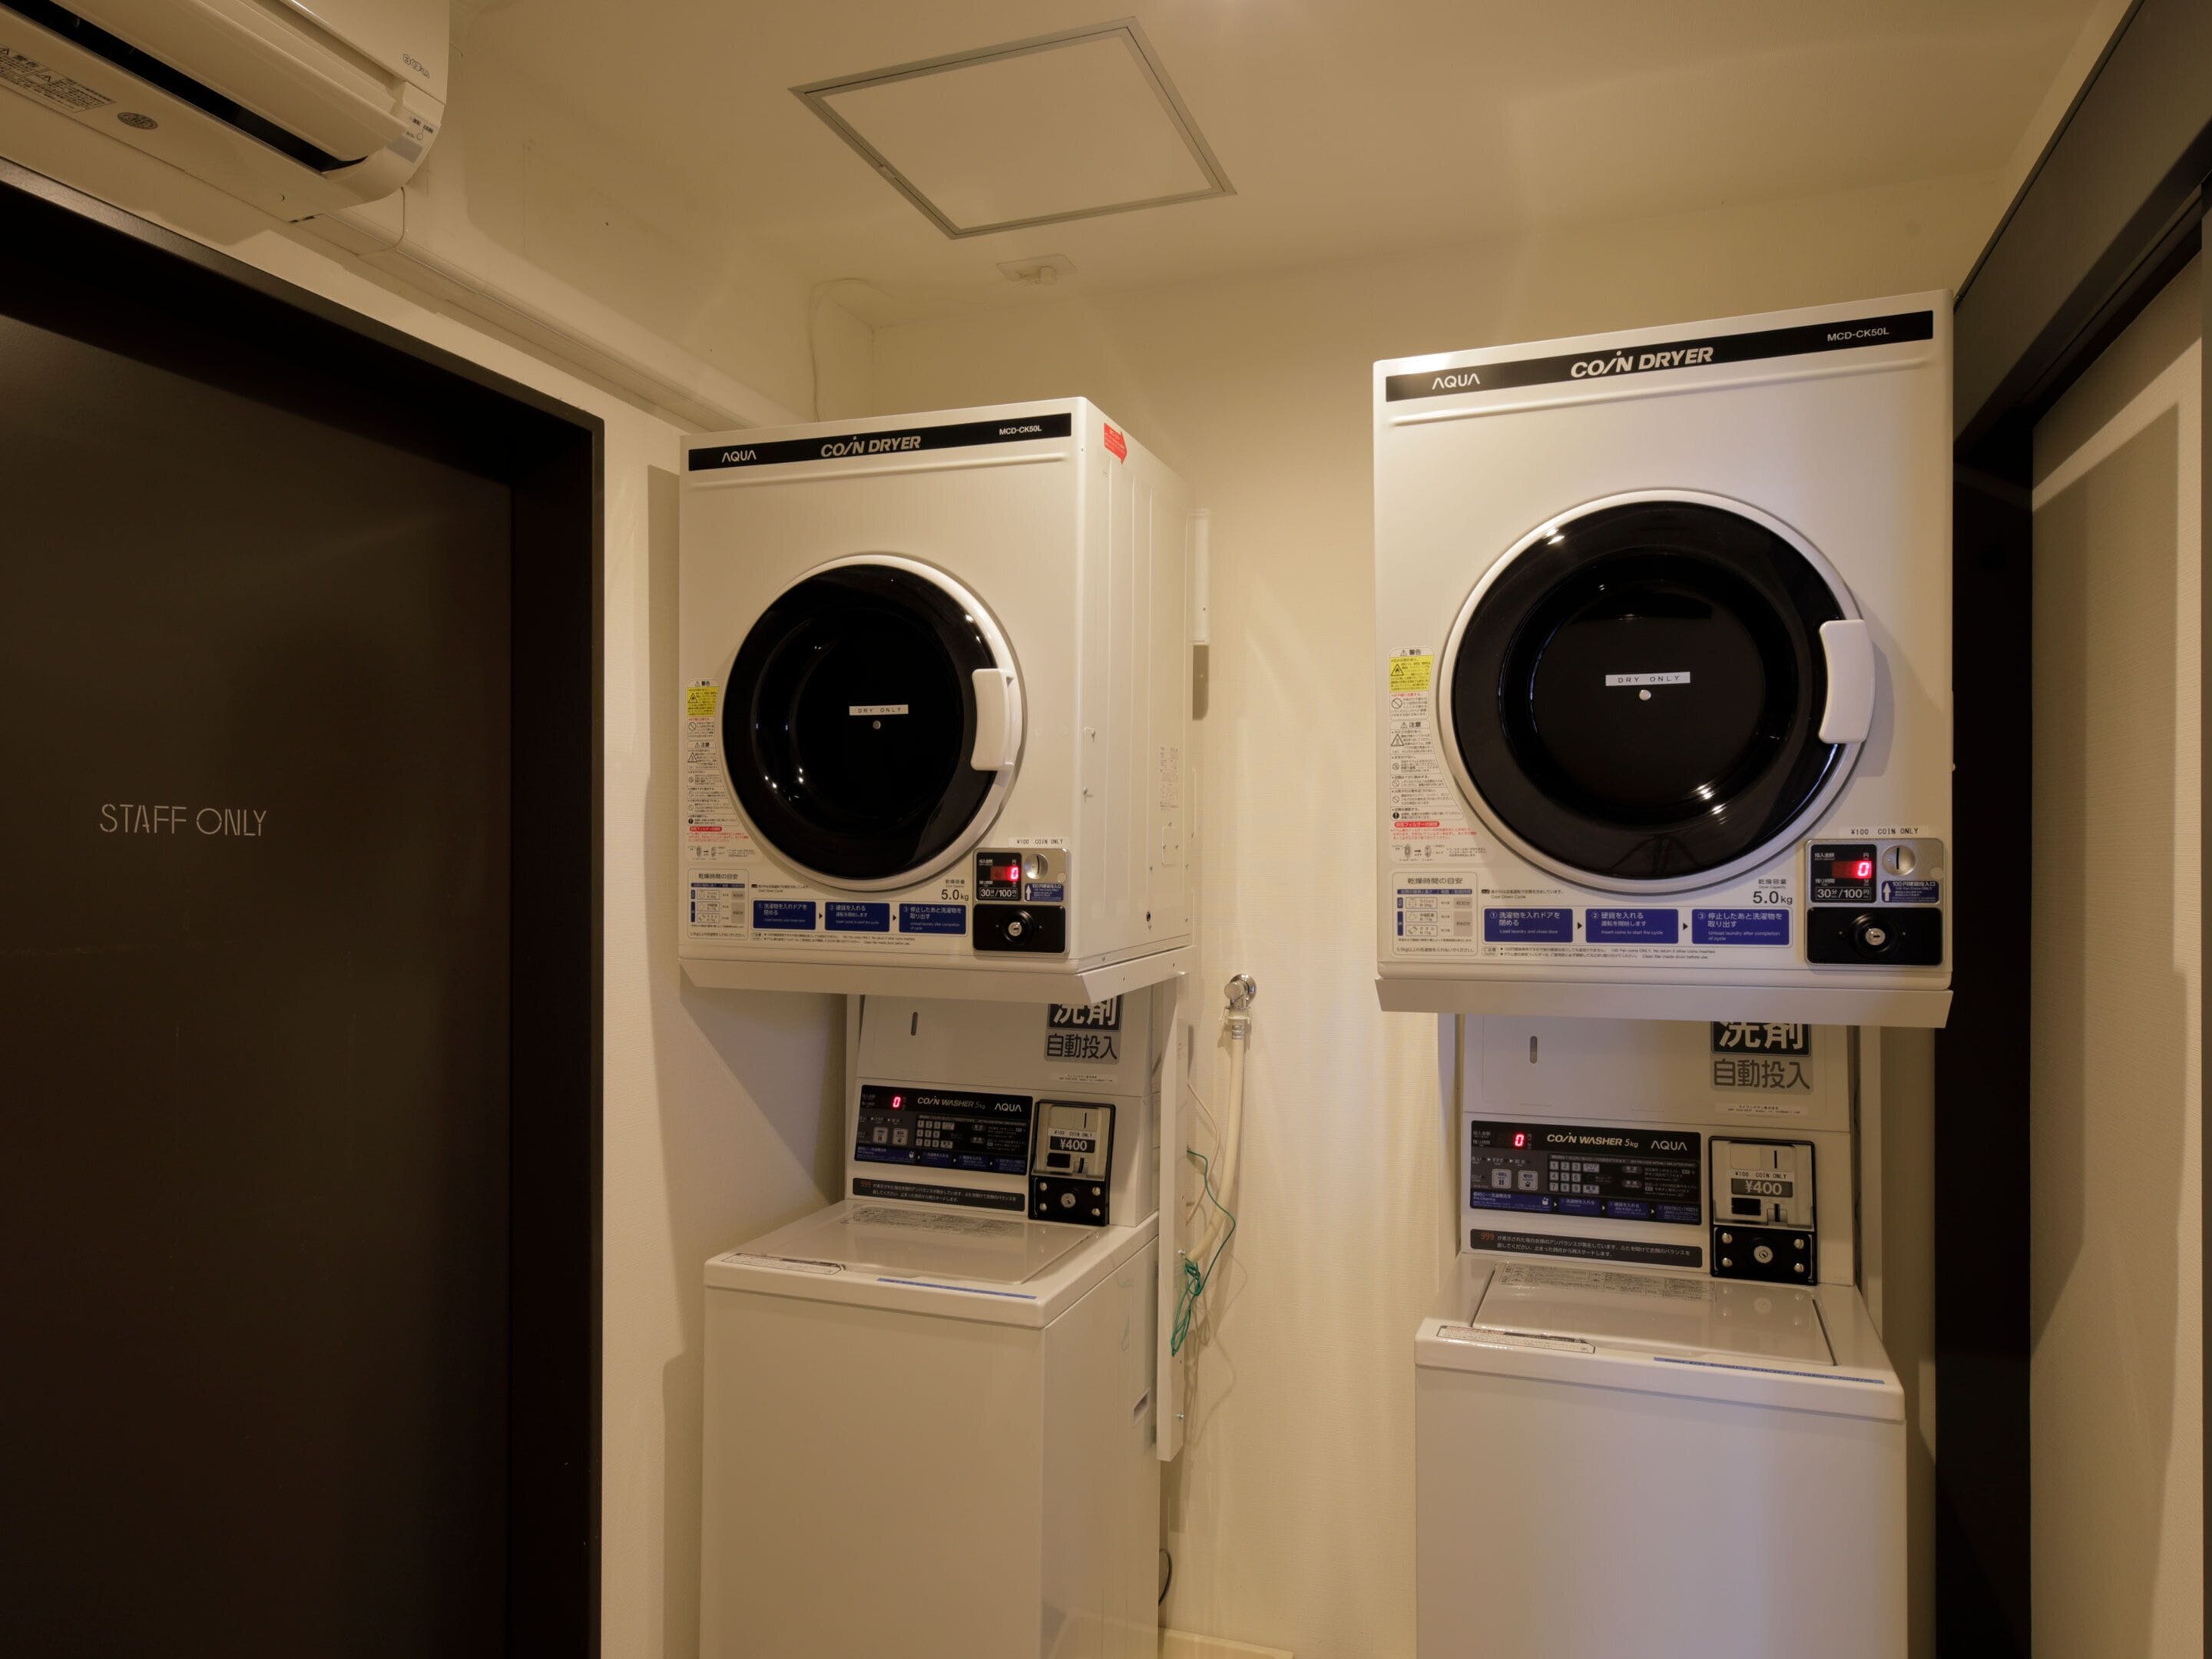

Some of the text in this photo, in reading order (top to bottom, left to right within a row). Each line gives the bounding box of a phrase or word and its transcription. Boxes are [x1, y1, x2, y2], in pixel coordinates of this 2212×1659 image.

[1827, 327, 1889, 342] MCD-CK50L
[1432, 346, 1714, 389] AQUA COIN DRYER
[998, 425, 1042, 435] MCD-CK50L
[721, 435, 922, 463] AQUA COIN DRYER
[100, 803, 267, 836] STAFF ONLY
[1010, 866, 1019, 879] 0
[1857, 862, 1869, 876] 0
[941, 889, 969, 901] 5.0kg
[1752, 891, 1793, 905] 5.0kg
[1718, 1022, 1803, 1050] 洗剤
[1046, 1033, 1118, 1060] 自動投入
[1714, 1058, 1810, 1089] 自動投入
[892, 1096, 902, 1108] 0
[917, 1095, 940, 1105] COIN
[942, 1099, 974, 1108] WASHER
[994, 1103, 1022, 1113] AQUA
[1059, 1138, 1088, 1151] ¥400
[1515, 1134, 1525, 1147] 0
[1547, 1132, 1639, 1148] COIN WASHER 5kg
[1651, 1140, 1687, 1151] AQUA
[1744, 1180, 1783, 1195] ¥400
[1480, 1232, 1495, 1240] 999
